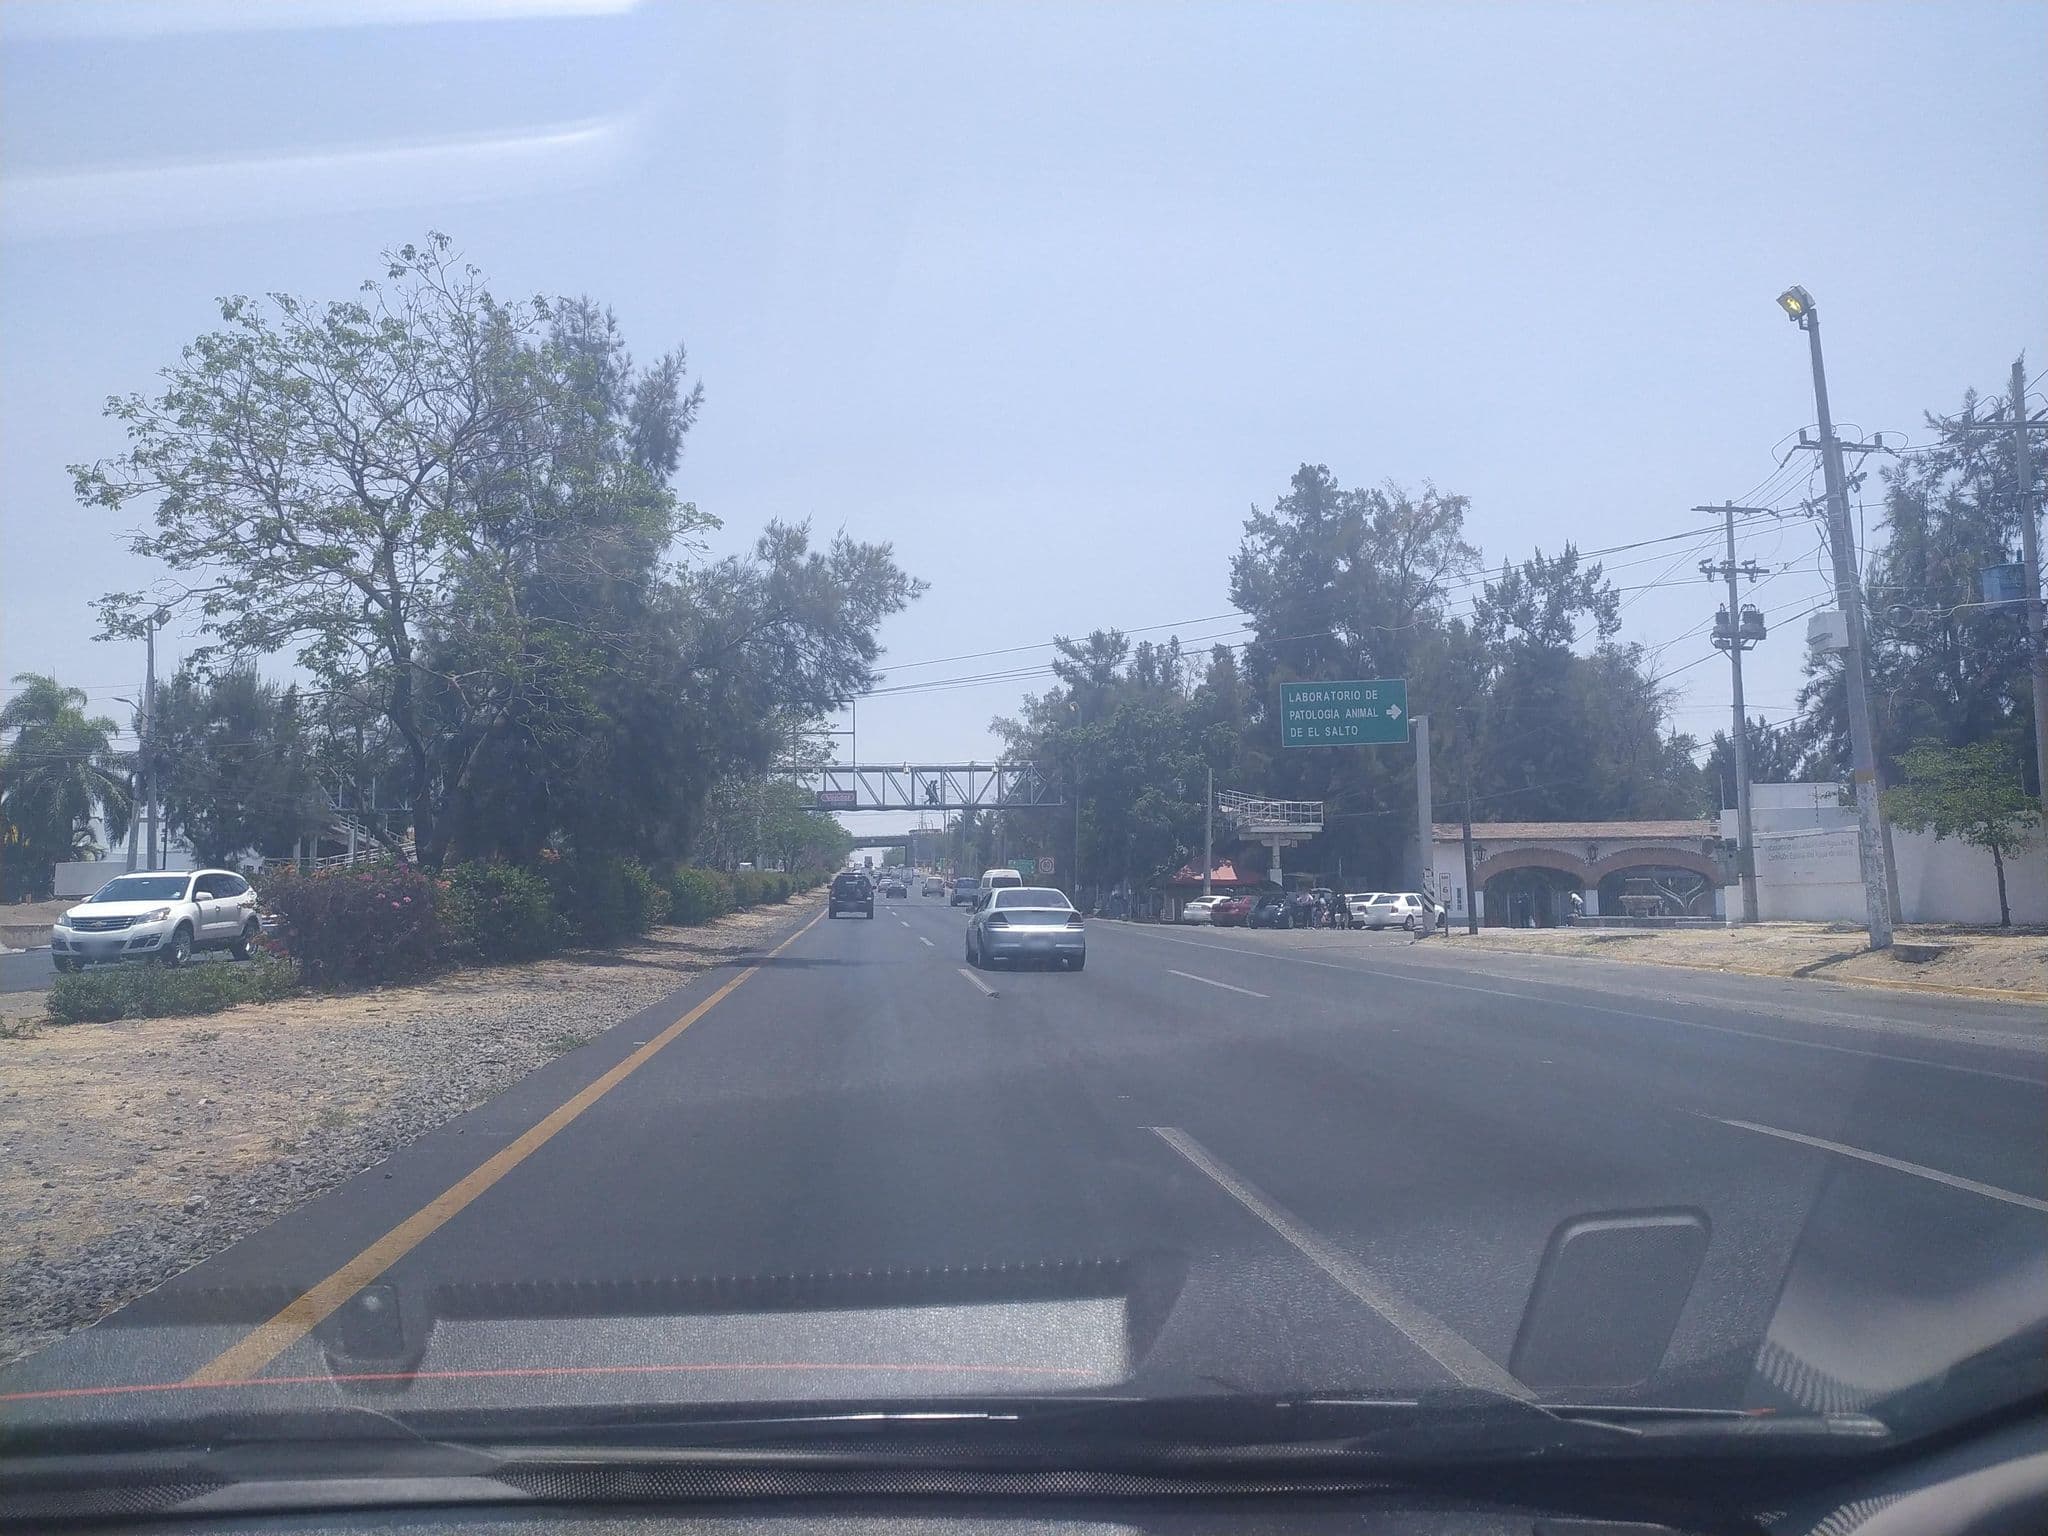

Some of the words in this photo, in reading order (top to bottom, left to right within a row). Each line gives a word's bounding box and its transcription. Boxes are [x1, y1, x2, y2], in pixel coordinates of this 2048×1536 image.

[1289, 690, 1360, 702] LABORATORIO
[1365, 689, 1378, 700] DE
[1345, 707, 1378, 718] ANIMAL
[1290, 727, 1303, 738] DE
[1308, 726, 1320, 737] EL
[1325, 725, 1358, 736] SALTO
